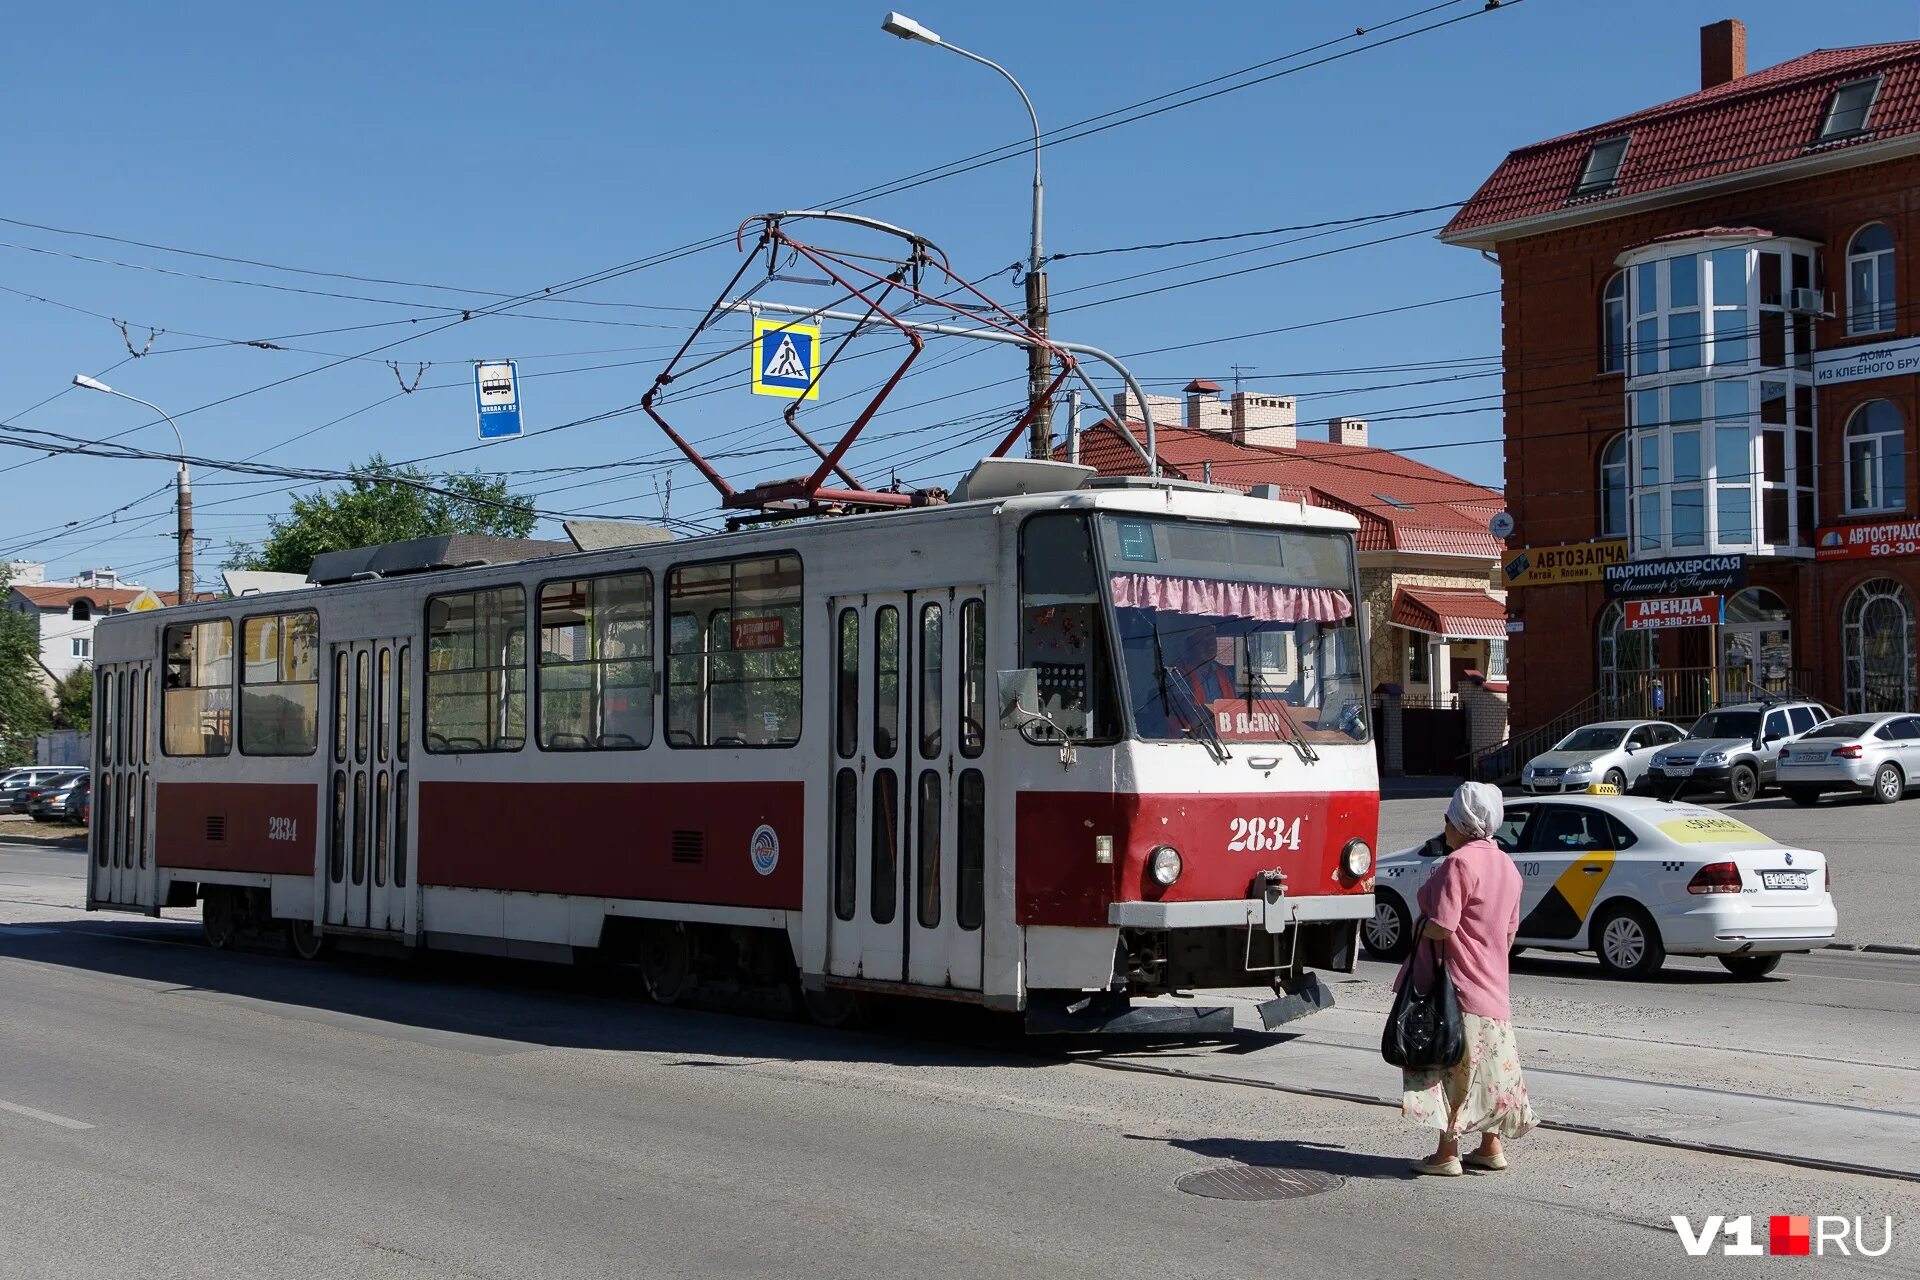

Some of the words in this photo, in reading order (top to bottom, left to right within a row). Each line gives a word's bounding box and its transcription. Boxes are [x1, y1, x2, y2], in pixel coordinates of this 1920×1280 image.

[1859, 349, 1893, 363] ДОМА
[1819, 370, 1832, 380] ИЗ
[1836, 361, 1894, 377] КЛЕЕНОГО
[1124, 524, 1144, 558] 2
[1537, 545, 1628, 568] АВТОЗАПЧА
[1528, 569, 1555, 581] Китай,
[1560, 566, 1593, 579] Япония,
[1606, 556, 1741, 580] ПАРИКМАХЕРСКАЯ
[1613, 578, 1667, 593] Маникюр
[1639, 599, 1703, 616] АРЕНДА
[1632, 615, 1711, 628] 8-909-380-71-41
[1219, 712, 1232, 732] В
[268, 816, 297, 842] 2834
[1227, 816, 1301, 852] 2834
[1523, 862, 1540, 876] 120
